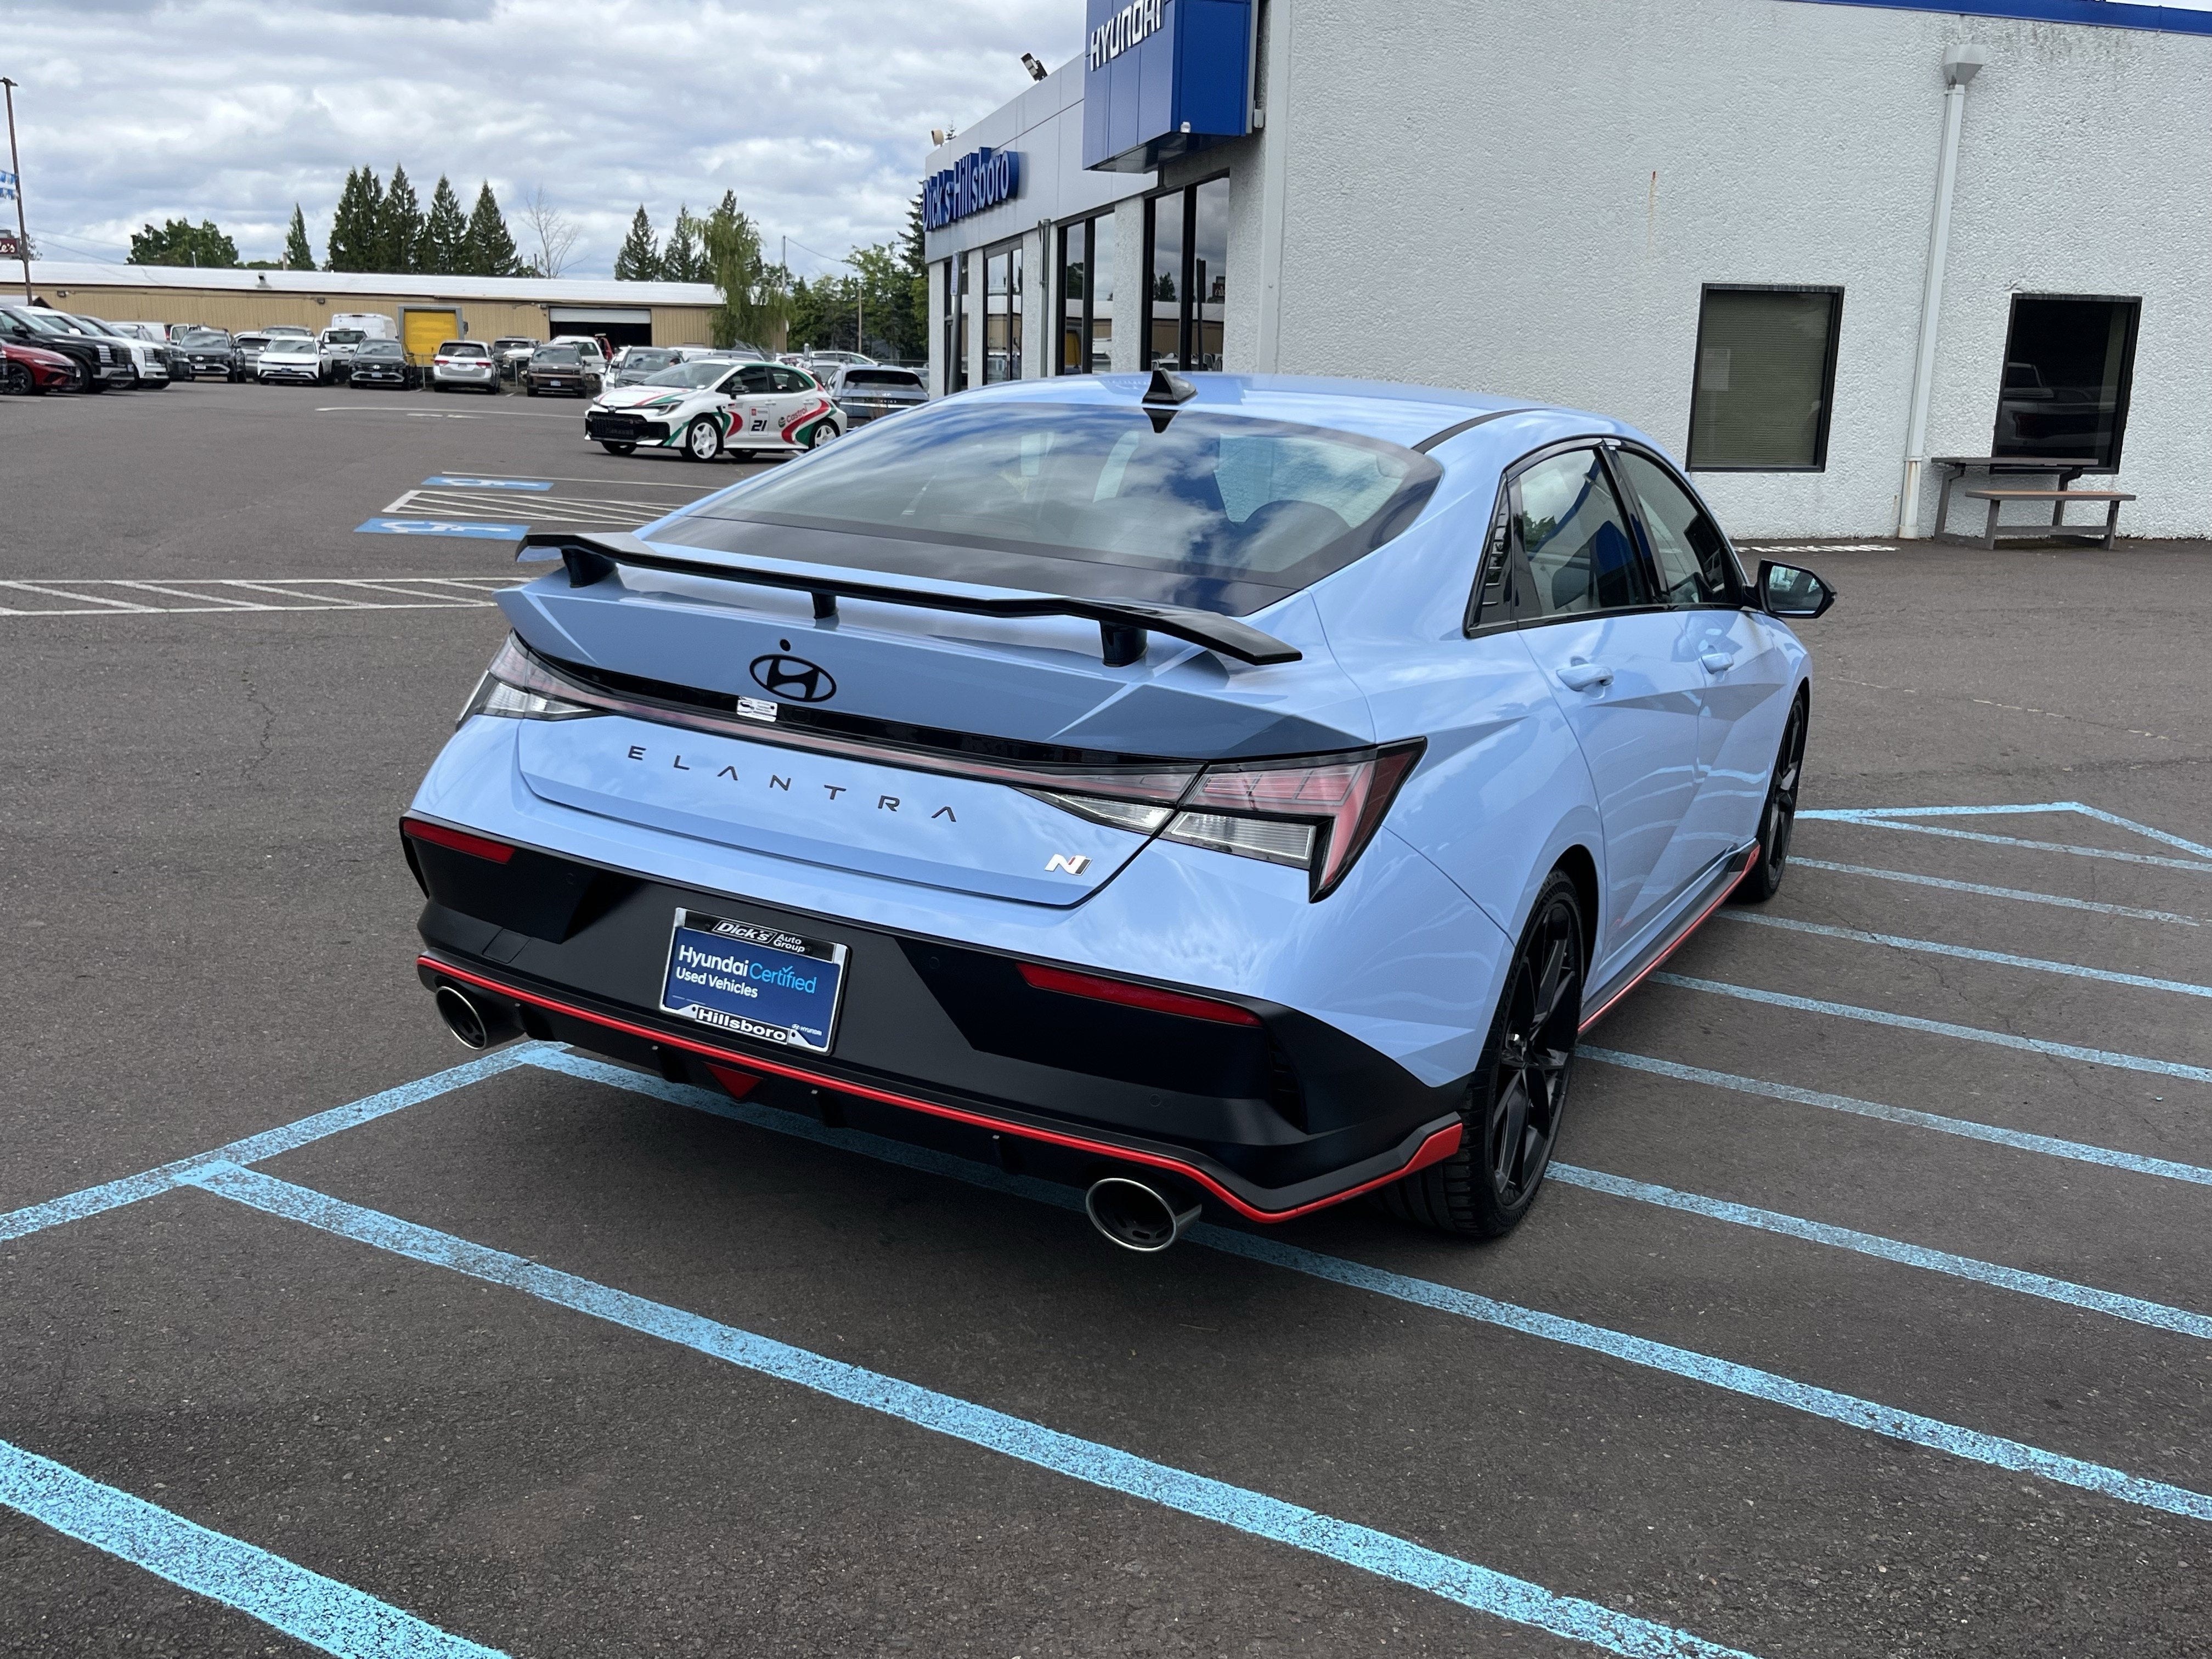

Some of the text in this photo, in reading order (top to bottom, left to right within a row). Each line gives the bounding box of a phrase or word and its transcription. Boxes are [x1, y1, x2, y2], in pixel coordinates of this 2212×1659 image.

[1091, 0, 1161, 72] HYUNDAI
[923, 147, 1011, 233] Dick's Hillsboro
[751, 420, 768, 432] 21
[787, 405, 809, 423] Castrol
[628, 745, 957, 822] ELANTRA
[1044, 854, 1092, 876] N
[716, 922, 770, 941] Dick's
[776, 934, 802, 945] Auto
[773, 939, 805, 953] Group
[676, 966, 758, 998] Used Vehicles
[679, 944, 817, 994] Hyundai Certified
[698, 1008, 786, 1041] Hillsboro
